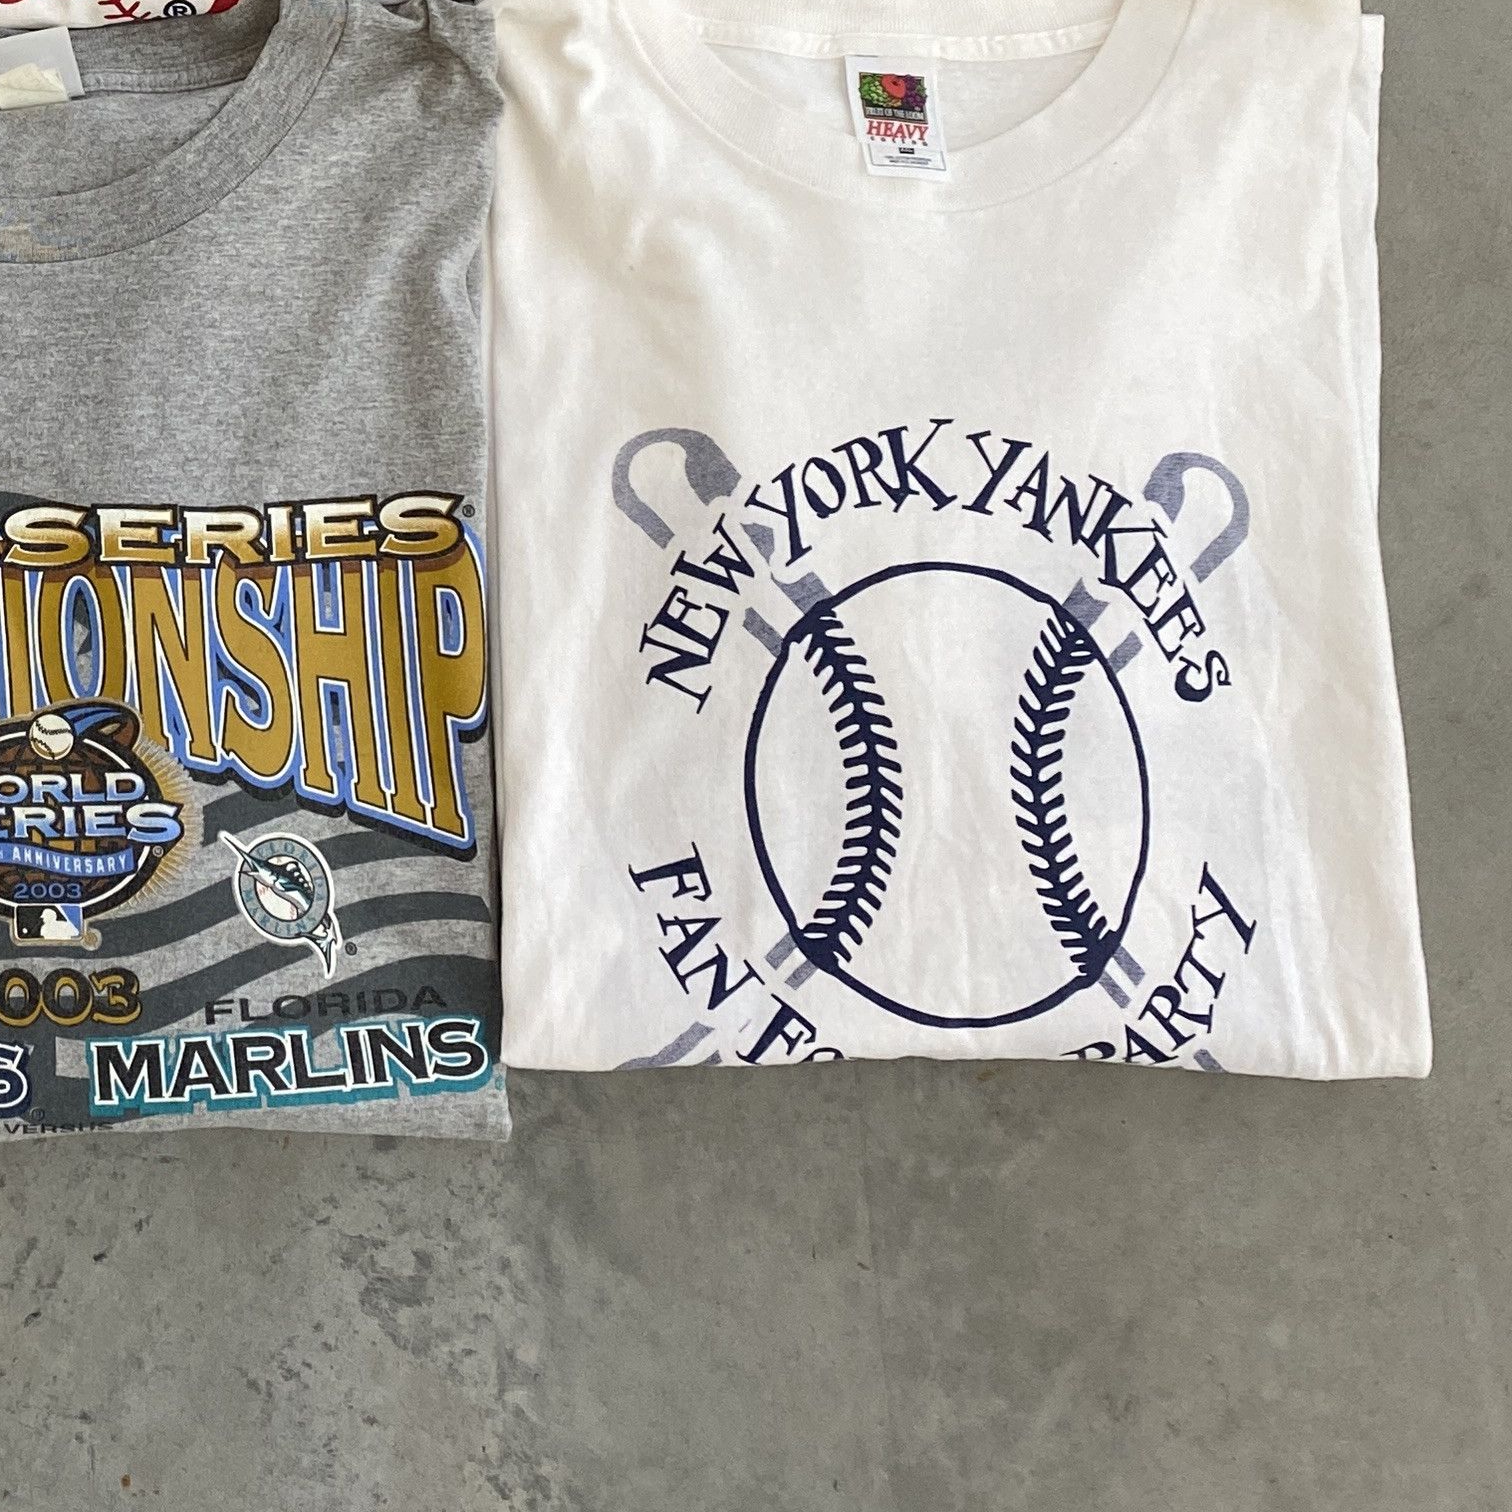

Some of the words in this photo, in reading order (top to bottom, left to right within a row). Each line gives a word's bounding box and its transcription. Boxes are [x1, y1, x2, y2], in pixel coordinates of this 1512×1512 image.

[867, 120, 928, 140] HEAVY
[0, 491, 464, 572] SERIES
[640, 513, 755, 715] NEW
[747, 417, 961, 565] YORK
[962, 430, 1231, 703] YANKEES
[12, 846, 129, 874] ANNIVERSARY
[13, 883, 83, 900] 2003
[628, 841, 765, 1011] FAN
[204, 980, 448, 1026] FLORIDA
[89, 1015, 491, 1120] MARLINS
